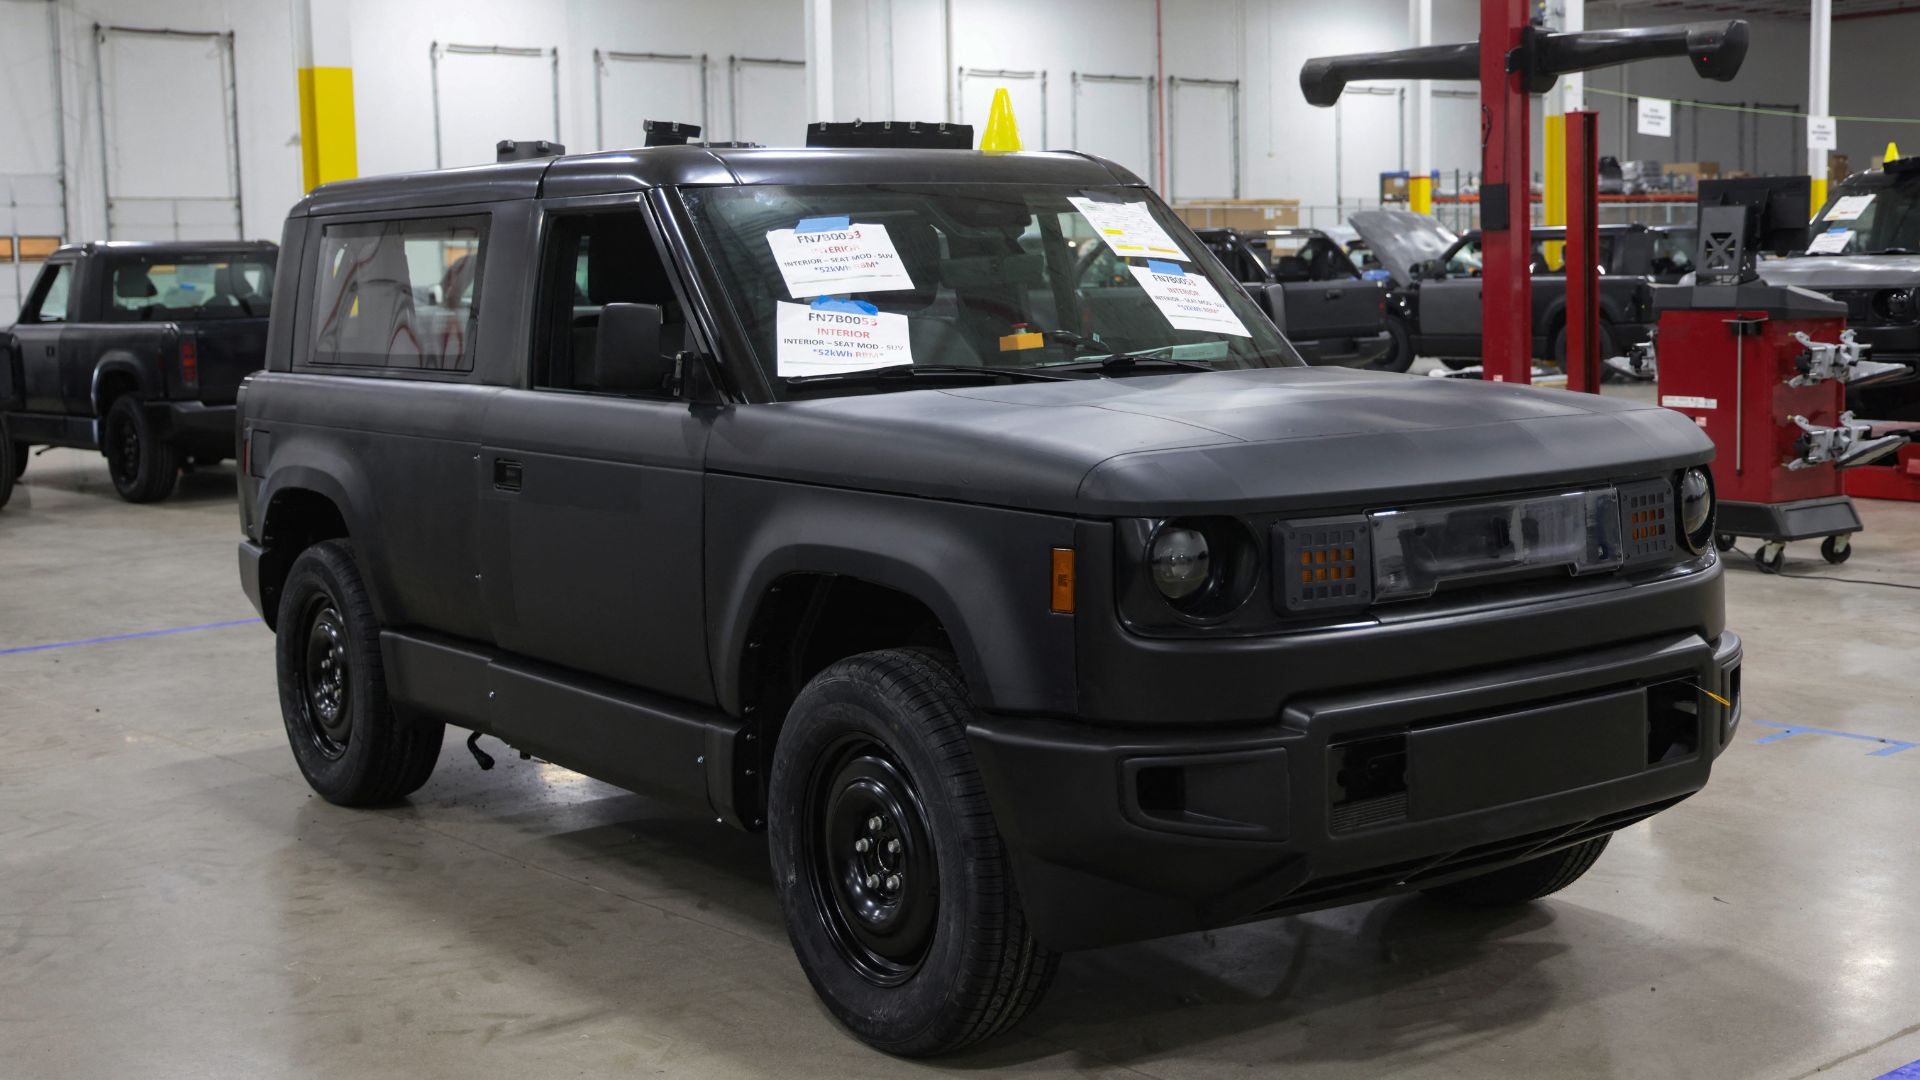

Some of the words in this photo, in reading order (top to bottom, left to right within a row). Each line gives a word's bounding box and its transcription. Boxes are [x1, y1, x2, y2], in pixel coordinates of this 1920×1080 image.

[811, 245, 861, 255] TERIO
[784, 258, 823, 268] INTERIOR
[830, 256, 850, 264] SEAT
[851, 253, 873, 262] MOD
[817, 328, 870, 339] INTERIOR
[784, 338, 824, 346] INTERIOR
